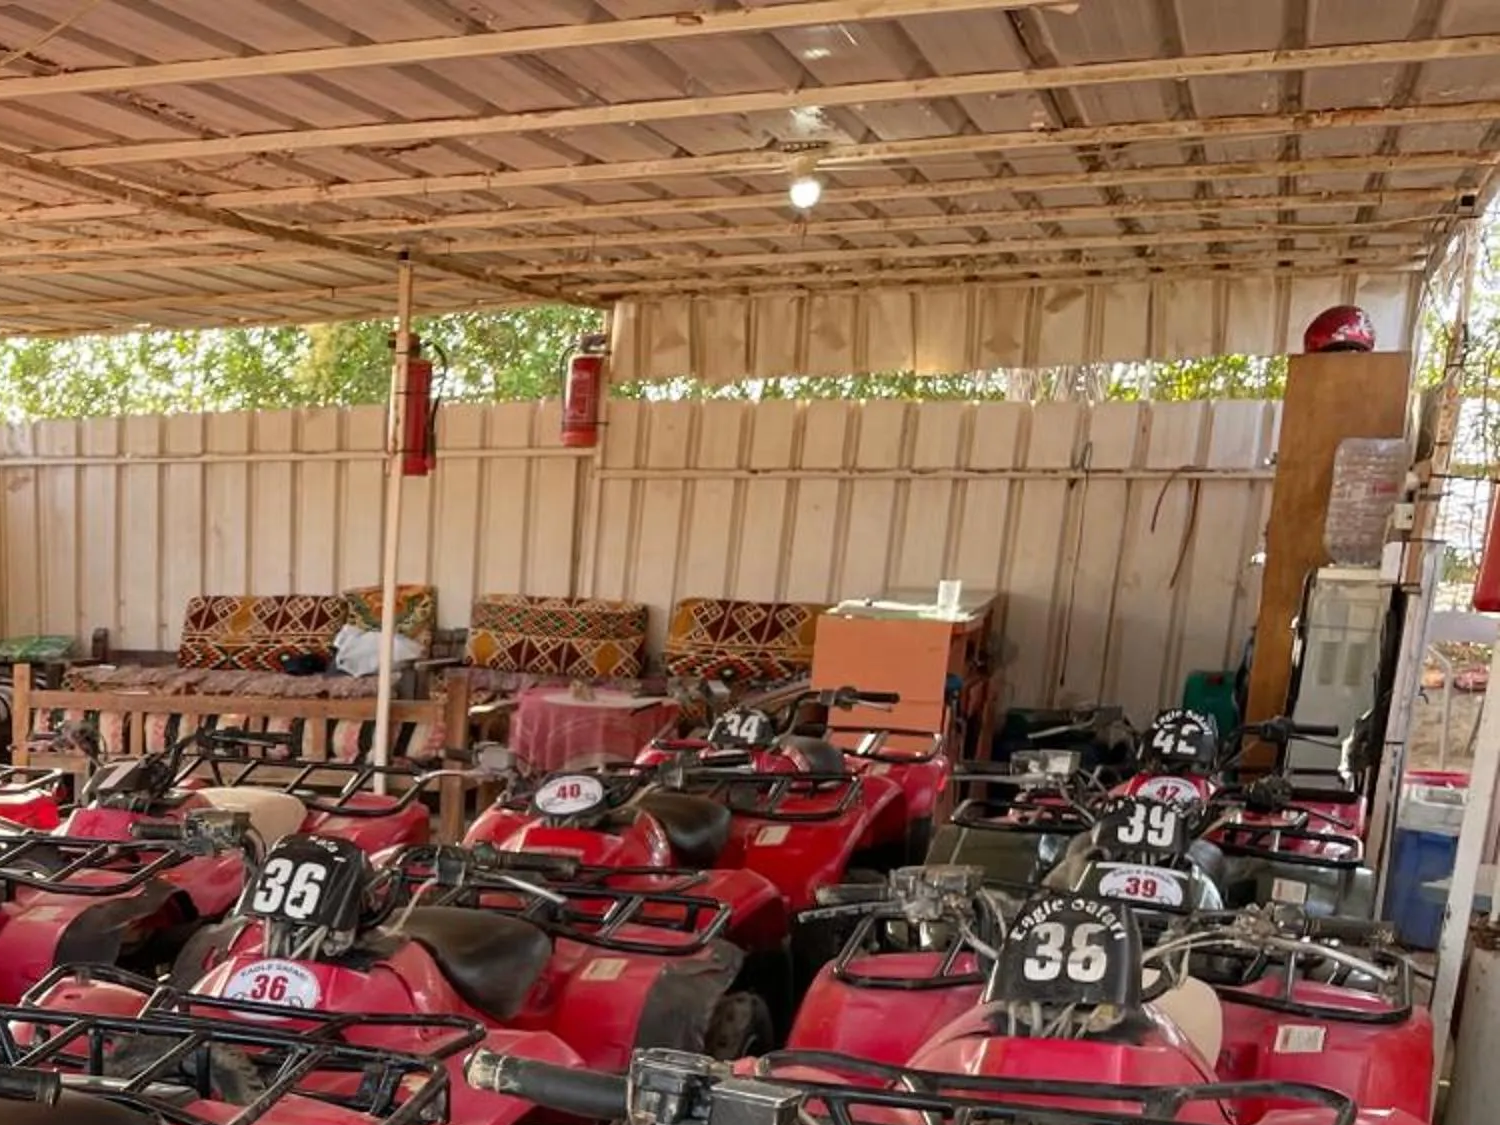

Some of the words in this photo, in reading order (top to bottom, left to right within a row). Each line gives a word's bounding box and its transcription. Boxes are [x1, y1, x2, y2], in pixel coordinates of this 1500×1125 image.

[1117, 803, 1176, 847] 39
[252, 857, 327, 920] 36
[1125, 877, 1157, 899] 39
[251, 974, 289, 1001] 36
